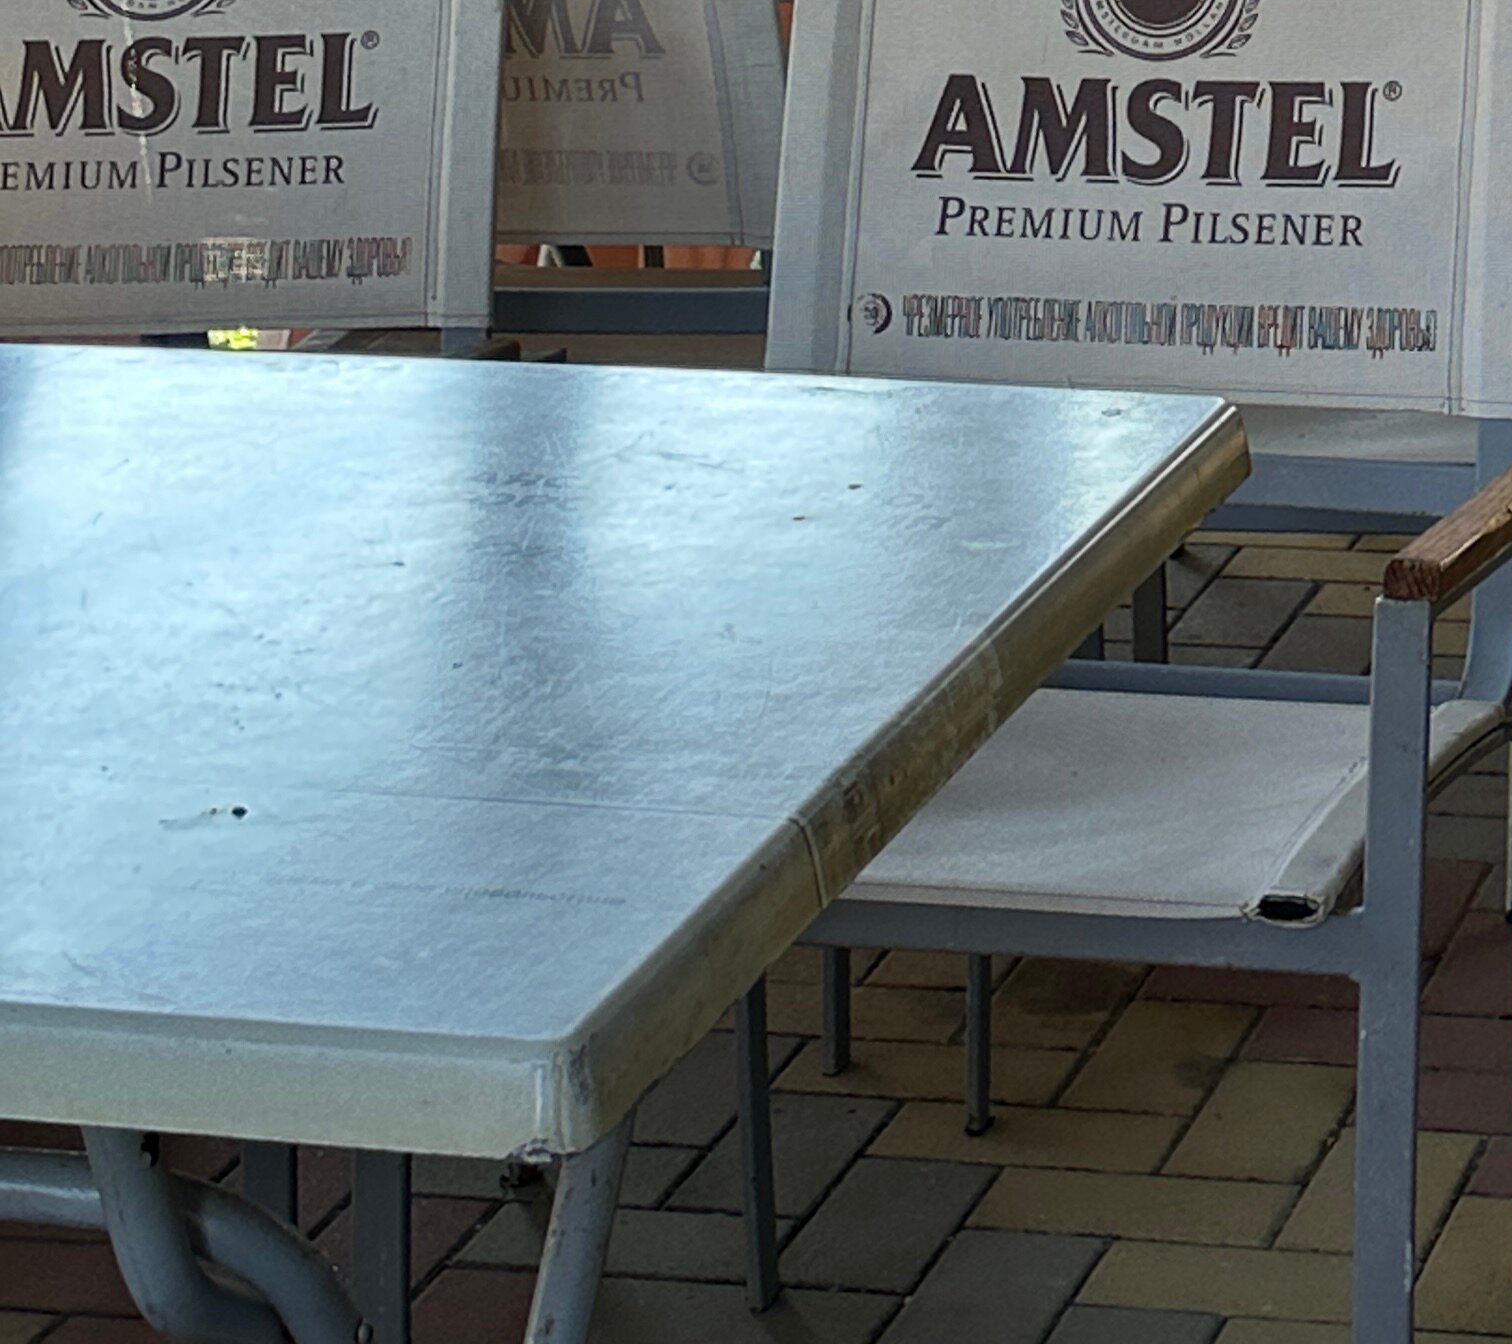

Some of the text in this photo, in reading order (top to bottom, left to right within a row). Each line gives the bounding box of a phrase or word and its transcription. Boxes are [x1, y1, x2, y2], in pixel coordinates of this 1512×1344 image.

[0, 33, 380, 138] MSTEL
[911, 74, 1401, 188] AMSTEL
[0, 151, 346, 191] EMIUM PILSENER
[935, 195, 1364, 247] PREMIUM PILSENER
